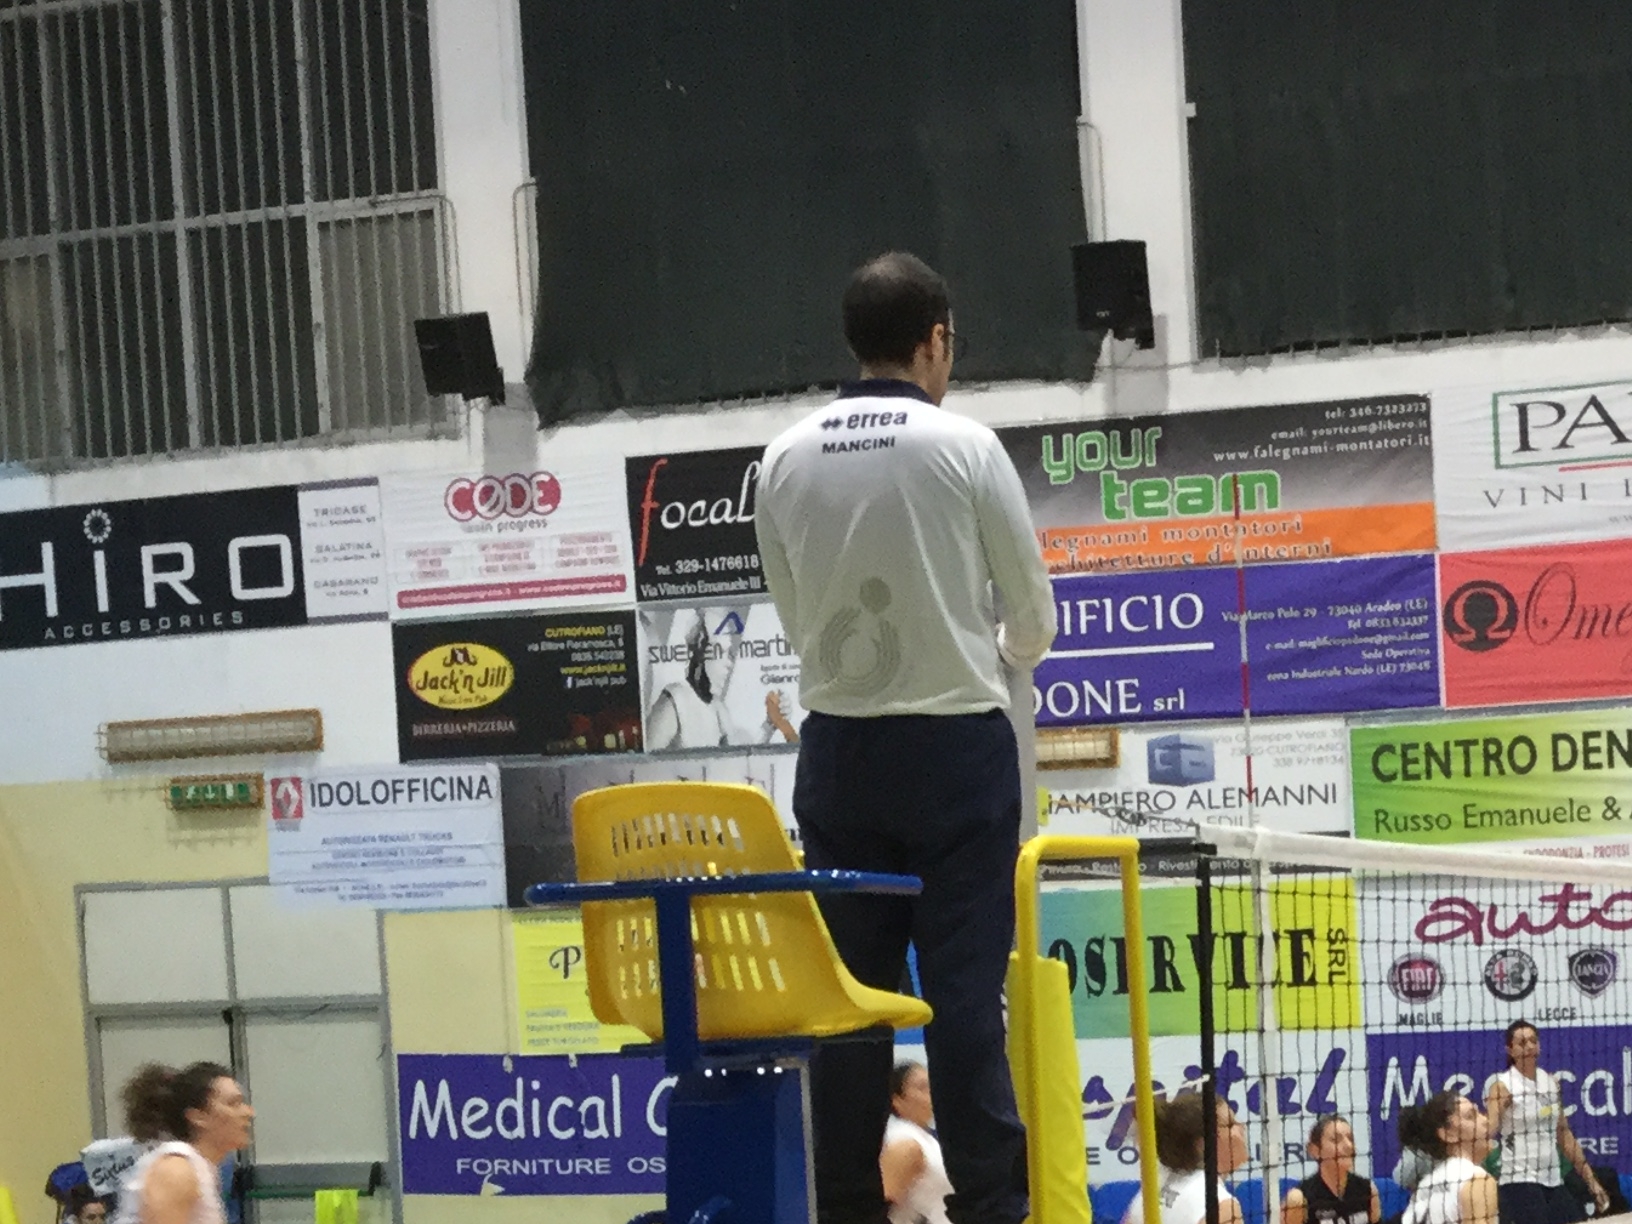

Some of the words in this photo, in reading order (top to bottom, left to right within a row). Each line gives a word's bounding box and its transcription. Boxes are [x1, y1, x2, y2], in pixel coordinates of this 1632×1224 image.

[822, 436, 896, 454] MANCINI
[1041, 427, 1162, 485] your
[1213, 434, 1430, 461] www.falegnami-montatori.it
[1100, 469, 1281, 520] team
[1483, 482, 1589, 510] VINI
[1041, 526, 1149, 552] legnami
[675, 554, 760, 574] 329-1476618
[1207, 540, 1333, 567] d'nterni
[640, 585, 658, 597] Via
[658, 582, 696, 596] Vittorio
[697, 577, 748, 593] Emanuele
[1060, 593, 1203, 636] IFICIO
[1221, 611, 1240, 622] Via
[1404, 598, 1428, 611] (LE)
[45, 610, 243, 639] ACCESSORIES
[416, 669, 474, 694] Jack'n
[477, 666, 507, 687] Jill
[1154, 688, 1185, 711] srl
[1371, 734, 1538, 783] CENTRO
[1048, 788, 1176, 815] IAMPIERO
[1186, 783, 1337, 811] ALEMANNI
[1374, 808, 1452, 834] Russo
[1463, 796, 1591, 829] Emanuele
[1601, 796, 1622, 821] &
[1327, 928, 1348, 984] SRL
[1400, 968, 1433, 991] FIAT
[1538, 1006, 1578, 1022] LECCE
[409, 1074, 622, 1140] Medical
[457, 1157, 612, 1175] FORNITURE
